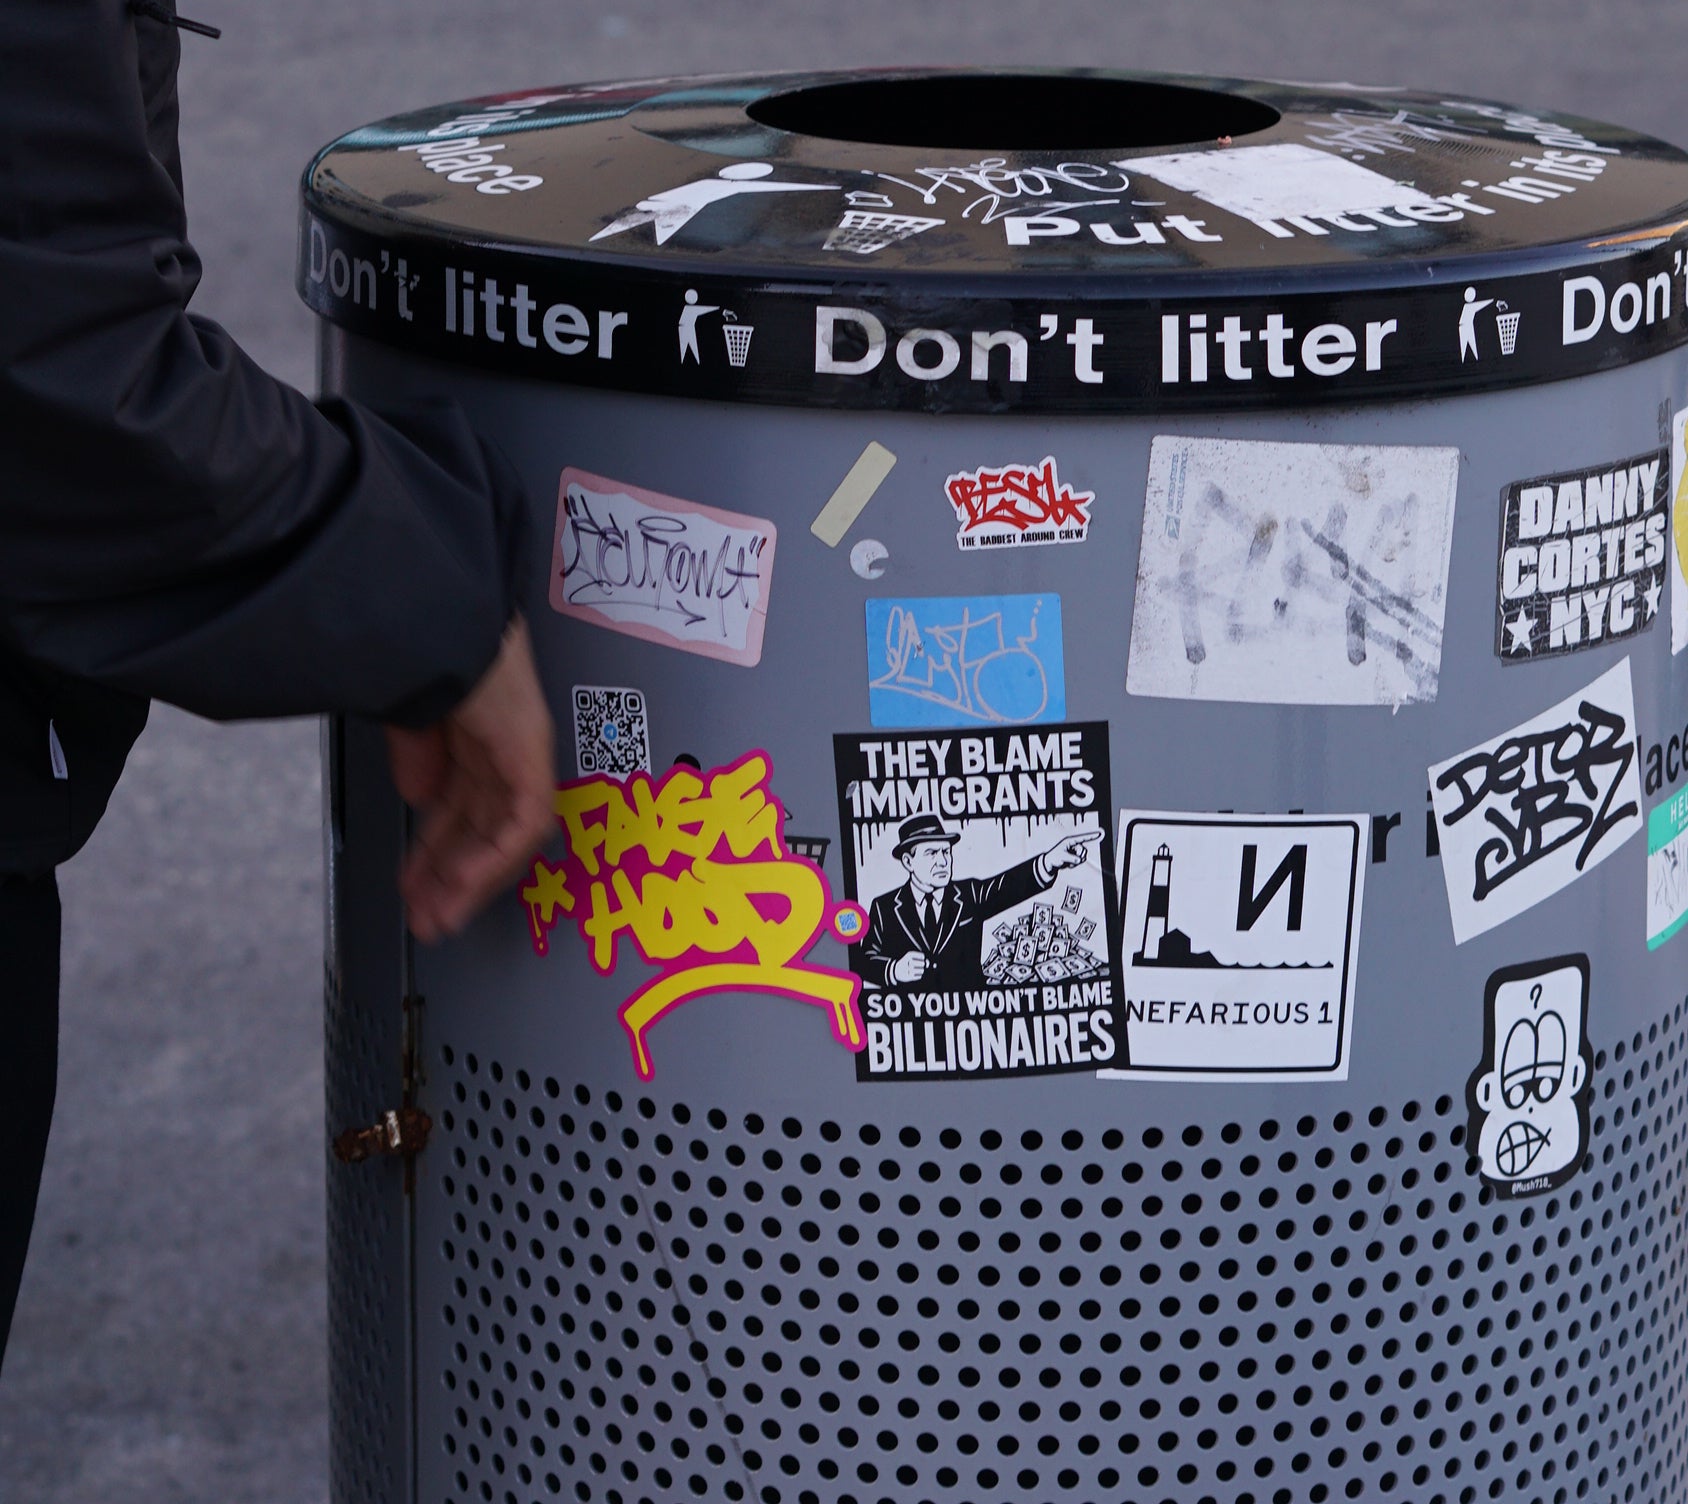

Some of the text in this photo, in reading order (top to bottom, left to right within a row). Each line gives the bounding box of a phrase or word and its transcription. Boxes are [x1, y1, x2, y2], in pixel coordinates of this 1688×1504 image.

[398, 137, 543, 194] place
[1460, 176, 1577, 204] in
[1510, 150, 1607, 182] its
[1004, 215, 1222, 245] Put
[309, 218, 628, 360] Don't litter
[815, 305, 1397, 384] Don't litter
[1519, 459, 1660, 539] DANNY
[961, 528, 1084, 547] THE BADDEST AROUND CREW
[1503, 512, 1666, 599] CORTES
[1550, 580, 1634, 648] NYC
[859, 731, 1083, 779] THEY BLAME
[851, 769, 1095, 818] IMMIGRANTS
[867, 980, 1112, 1019] SO YOU WON'T BLAME
[867, 1009, 1115, 1073] BILLIONAIRES
